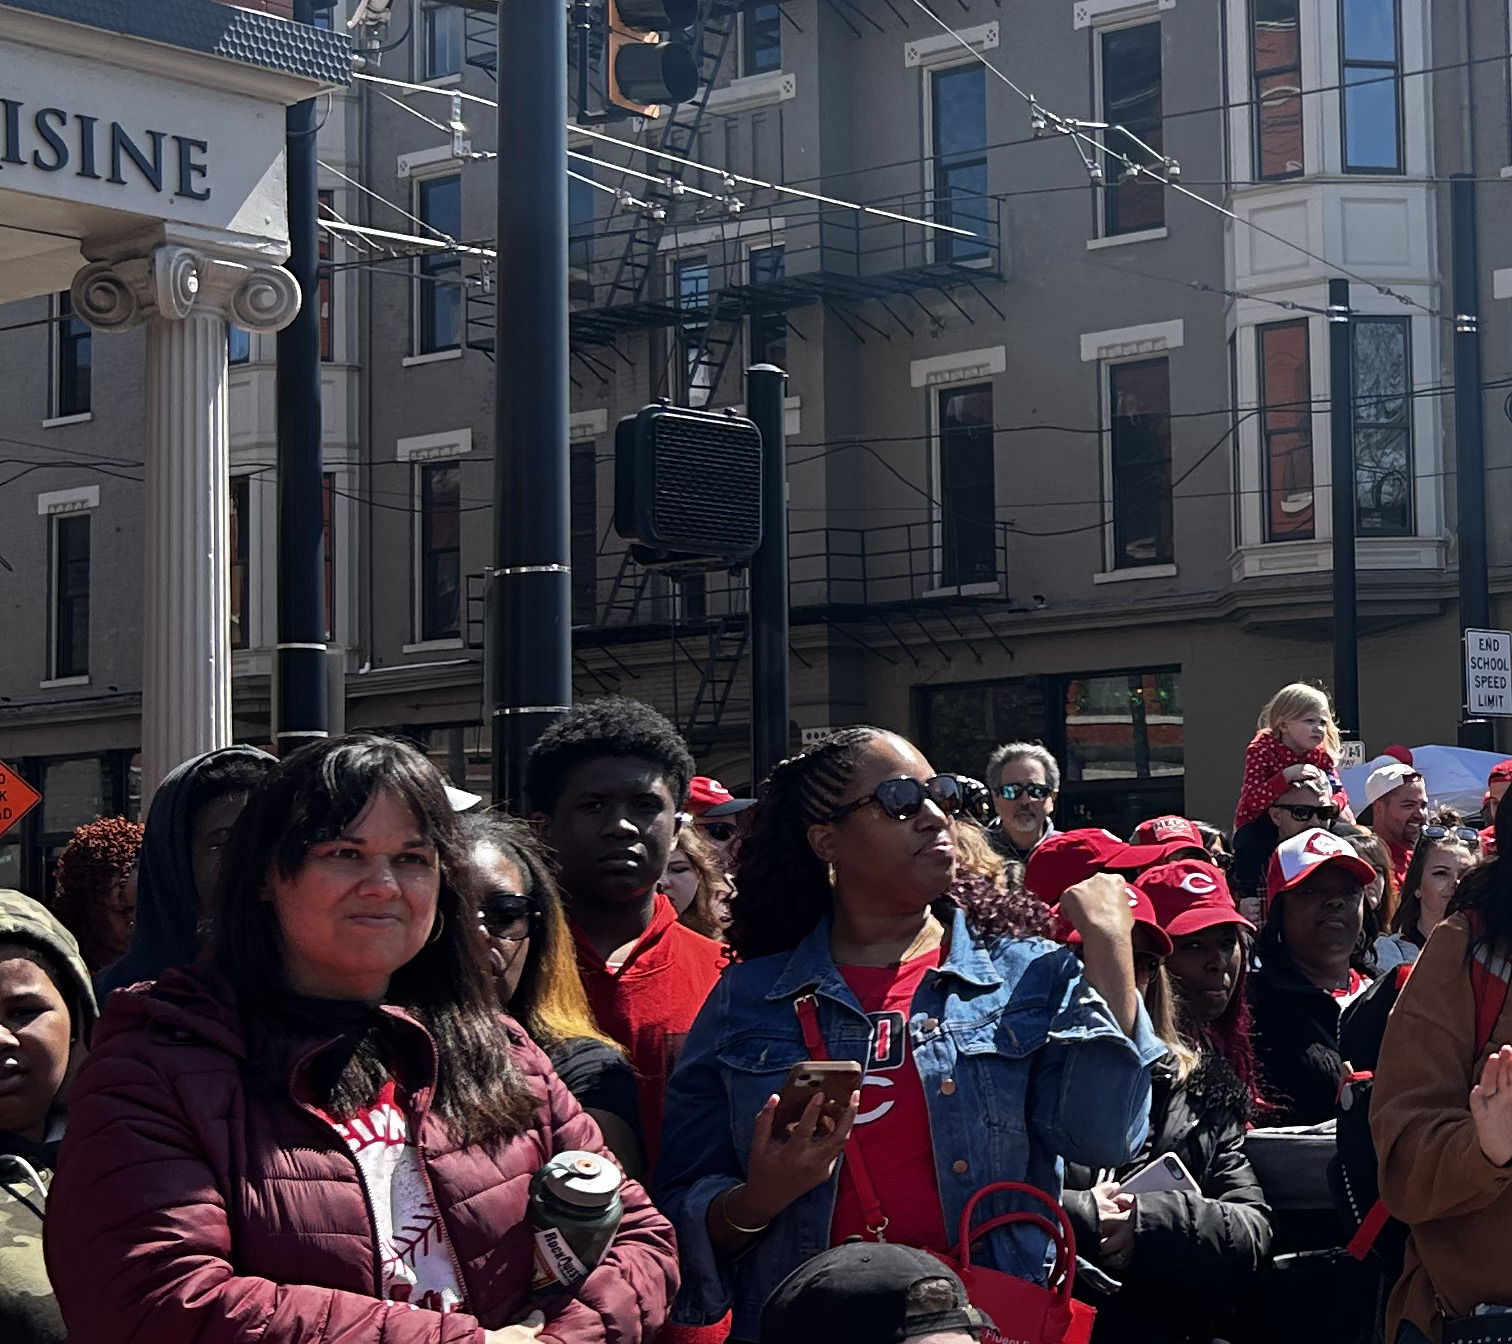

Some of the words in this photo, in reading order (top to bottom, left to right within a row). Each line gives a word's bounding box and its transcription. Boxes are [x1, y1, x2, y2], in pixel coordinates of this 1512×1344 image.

[1478, 637, 1500, 652] END
[1470, 656, 1510, 672] SCHOOL
[1474, 675, 1507, 690] SPEED
[1477, 694, 1504, 709] LIMIT
[1181, 871, 1218, 894] C
